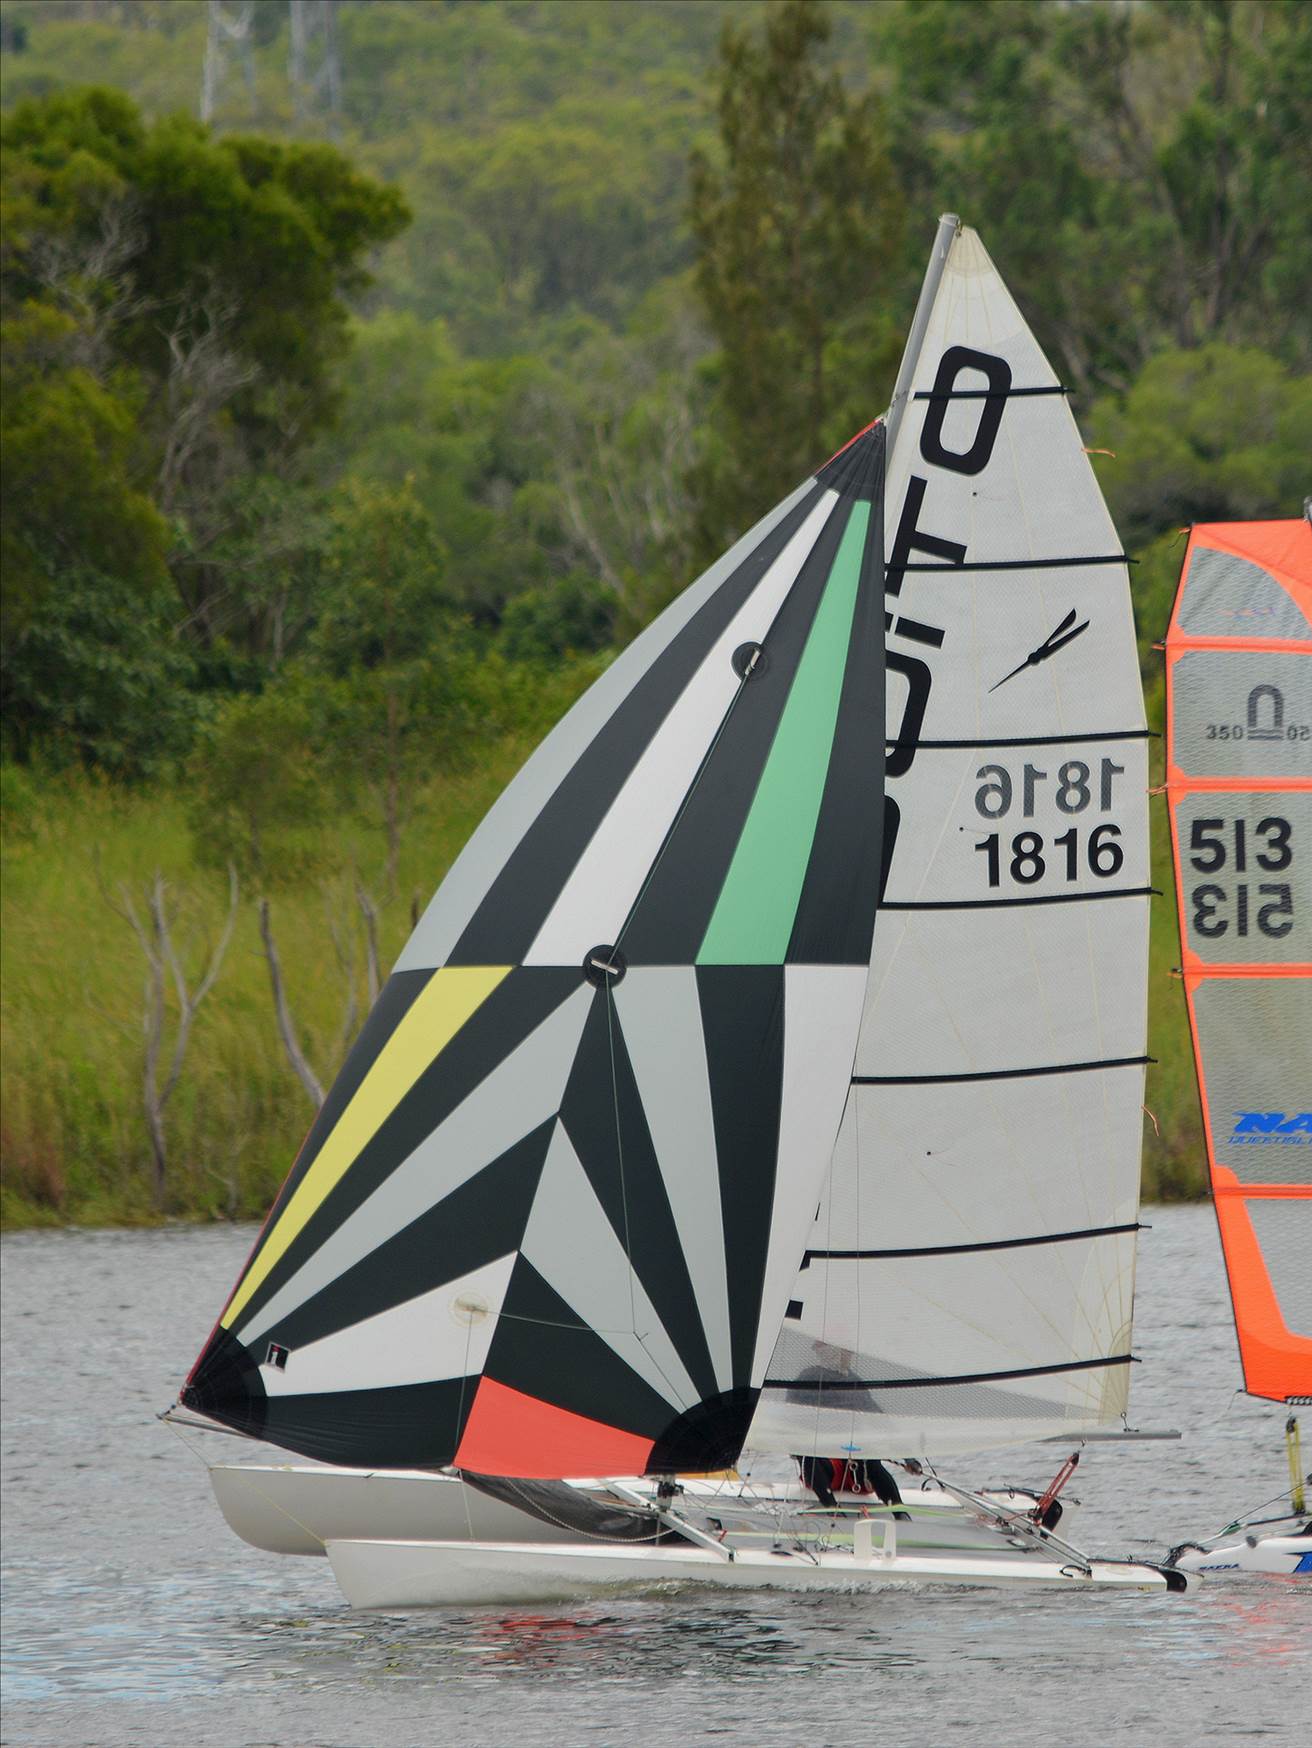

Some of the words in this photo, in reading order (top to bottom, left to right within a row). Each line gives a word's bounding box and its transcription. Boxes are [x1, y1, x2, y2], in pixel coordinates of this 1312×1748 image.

[1206, 724, 1243, 740] 350
[974, 823, 1125, 888] 1816
[1190, 817, 1293, 874] 513
